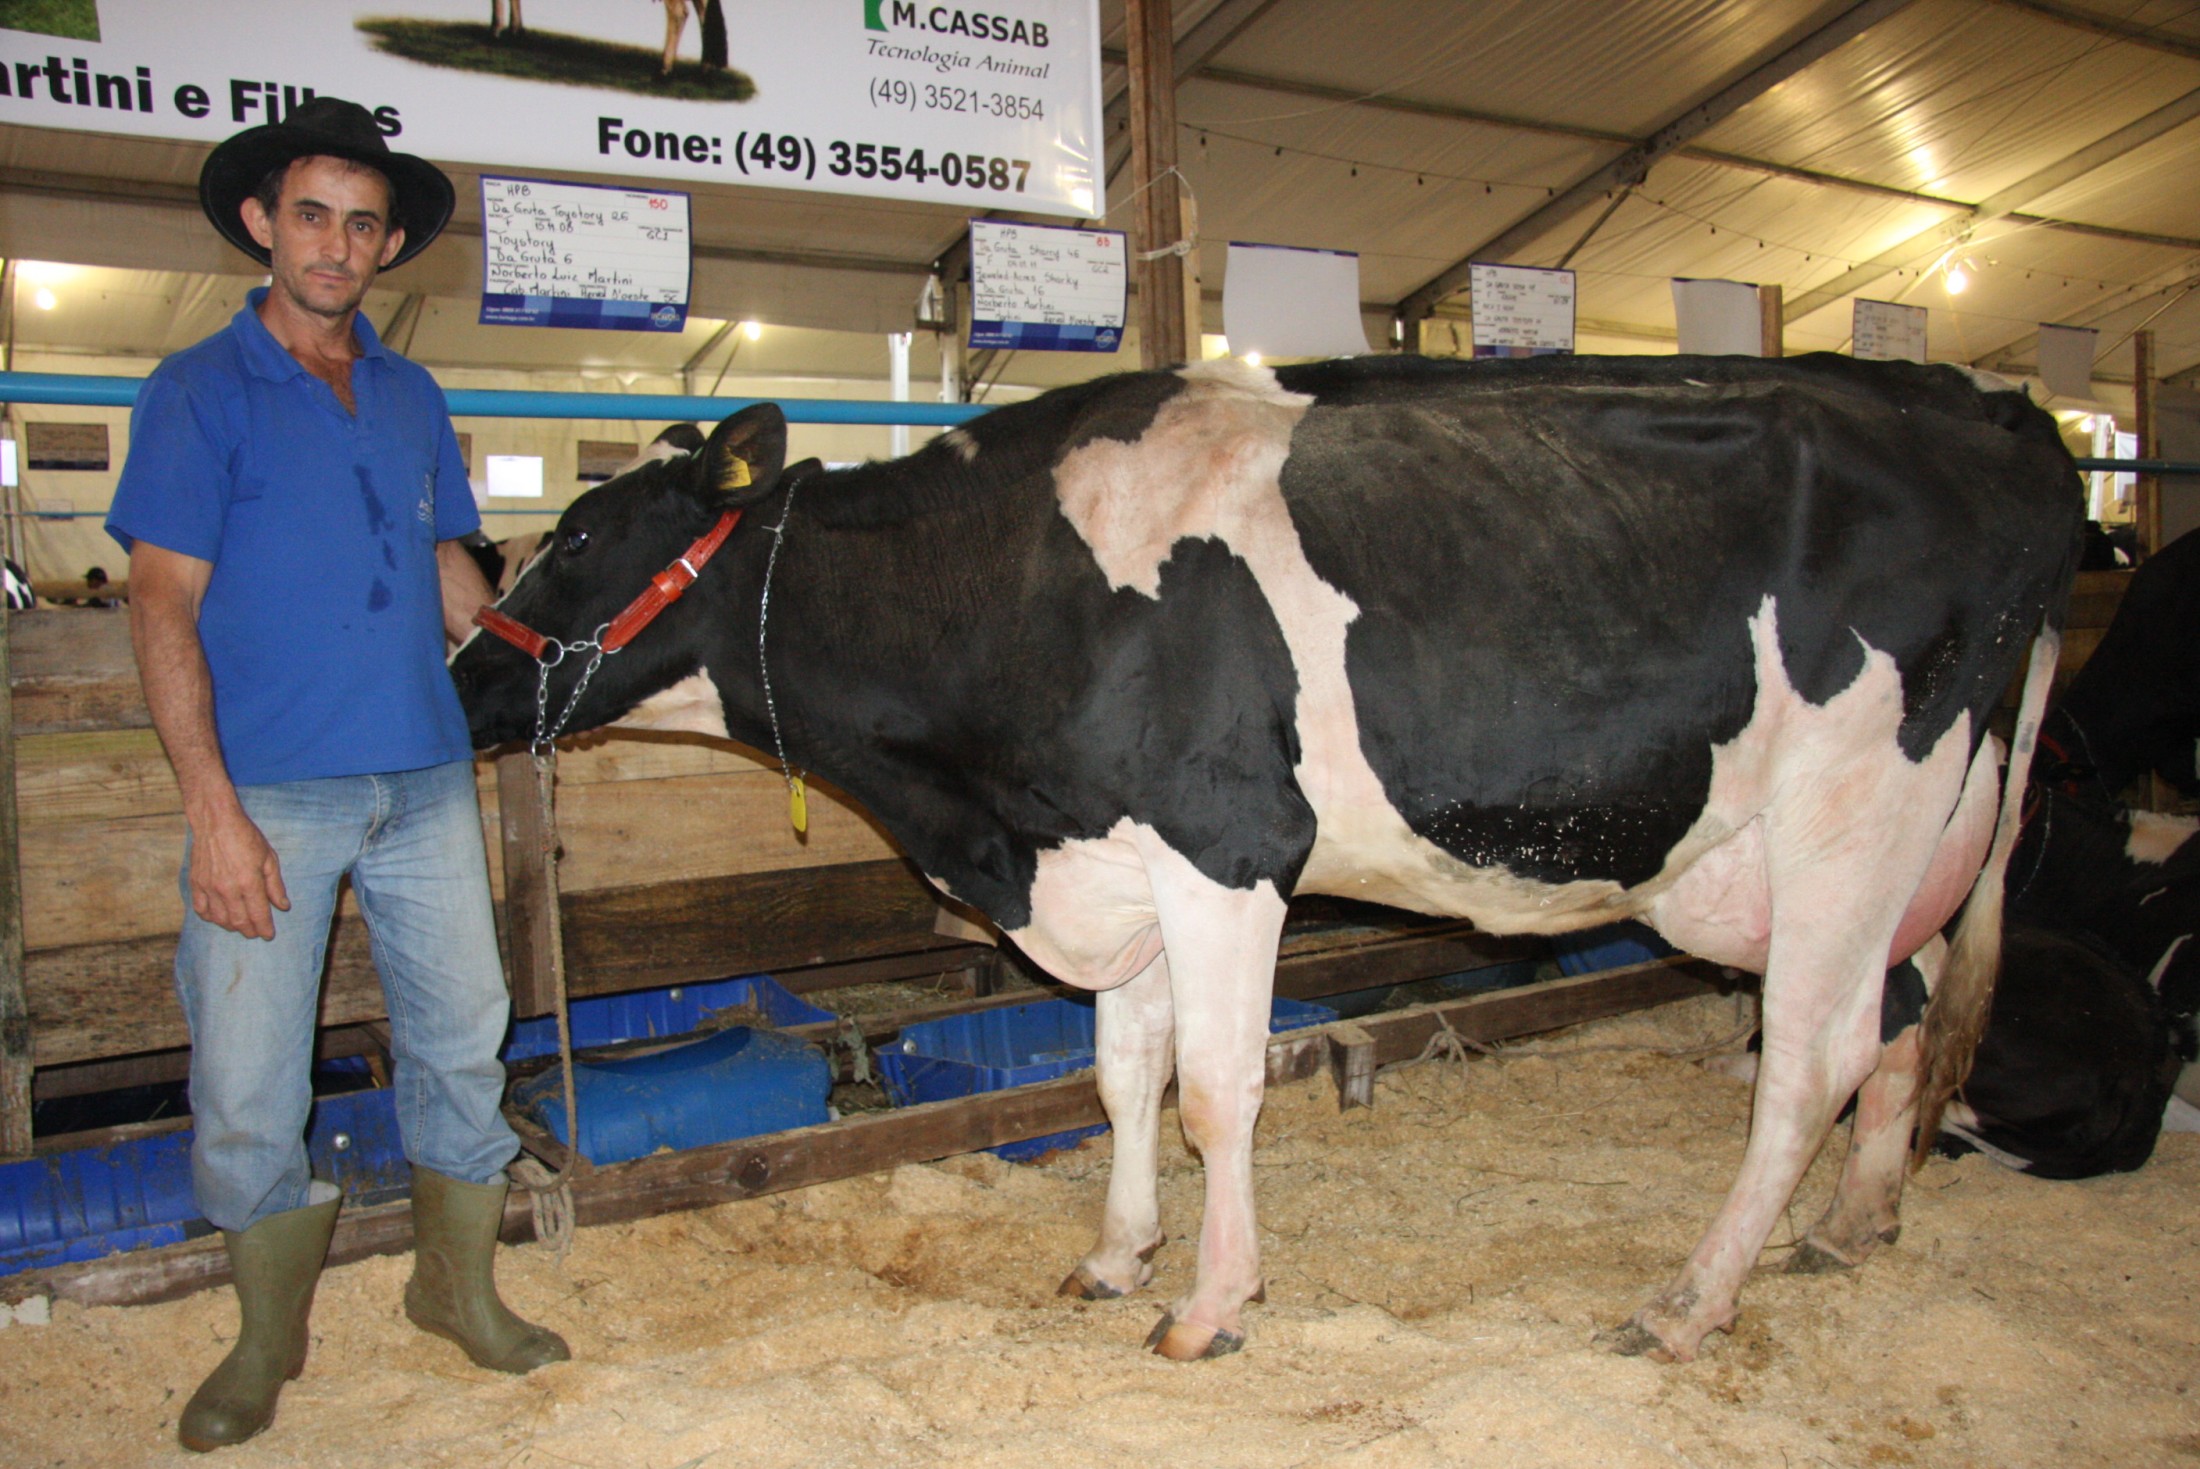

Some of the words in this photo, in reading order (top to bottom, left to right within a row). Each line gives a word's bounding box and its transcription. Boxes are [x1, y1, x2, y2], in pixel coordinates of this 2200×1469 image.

[892, 0, 1050, 48] M.CASSAB
[867, 38, 971, 73] Tecnologia
[976, 55, 1051, 79] Animal
[174, 84, 211, 119] e
[230, 79, 403, 138] Fils
[870, 77, 917, 112] (49)
[925, 84, 1045, 121] 3521-3854
[598, 116, 723, 165] Fone:
[735, 131, 817, 181] (49)
[828, 140, 1032, 194] 3554-0587
[507, 184, 532, 197] HPB
[491, 201, 510, 214] Da
[495, 247, 515, 264] Da
[520, 249, 558, 265] Gruta
[497, 230, 555, 256] Toystory
[491, 264, 547, 281] Norberto
[587, 266, 633, 285] Martini
